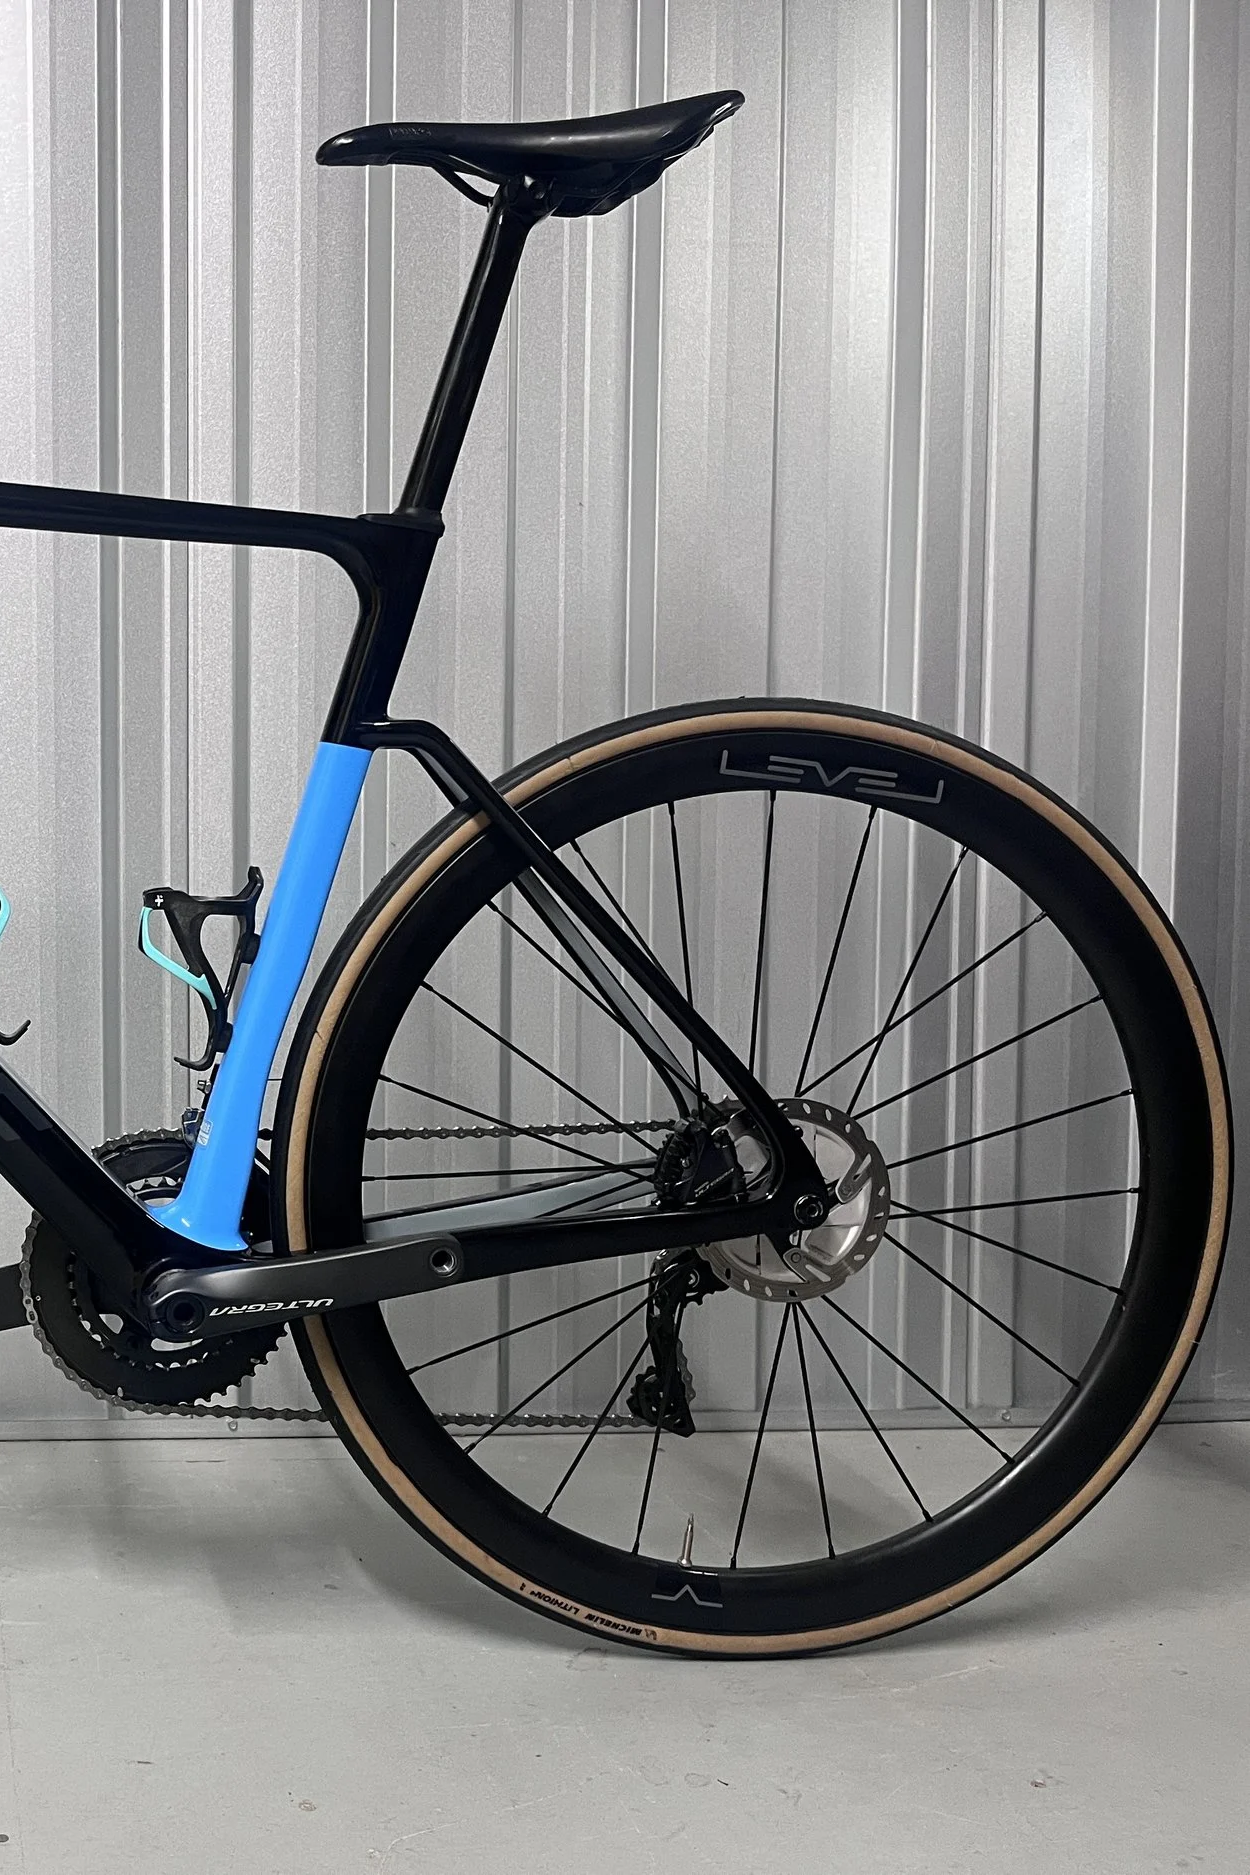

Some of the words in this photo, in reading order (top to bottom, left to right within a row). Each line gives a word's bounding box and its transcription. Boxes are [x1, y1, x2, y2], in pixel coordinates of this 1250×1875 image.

[719, 749, 945, 804] LEVEL
[209, 1298, 334, 1317] ULTEGRA
[585, 1613, 642, 1636] MICHELIN
